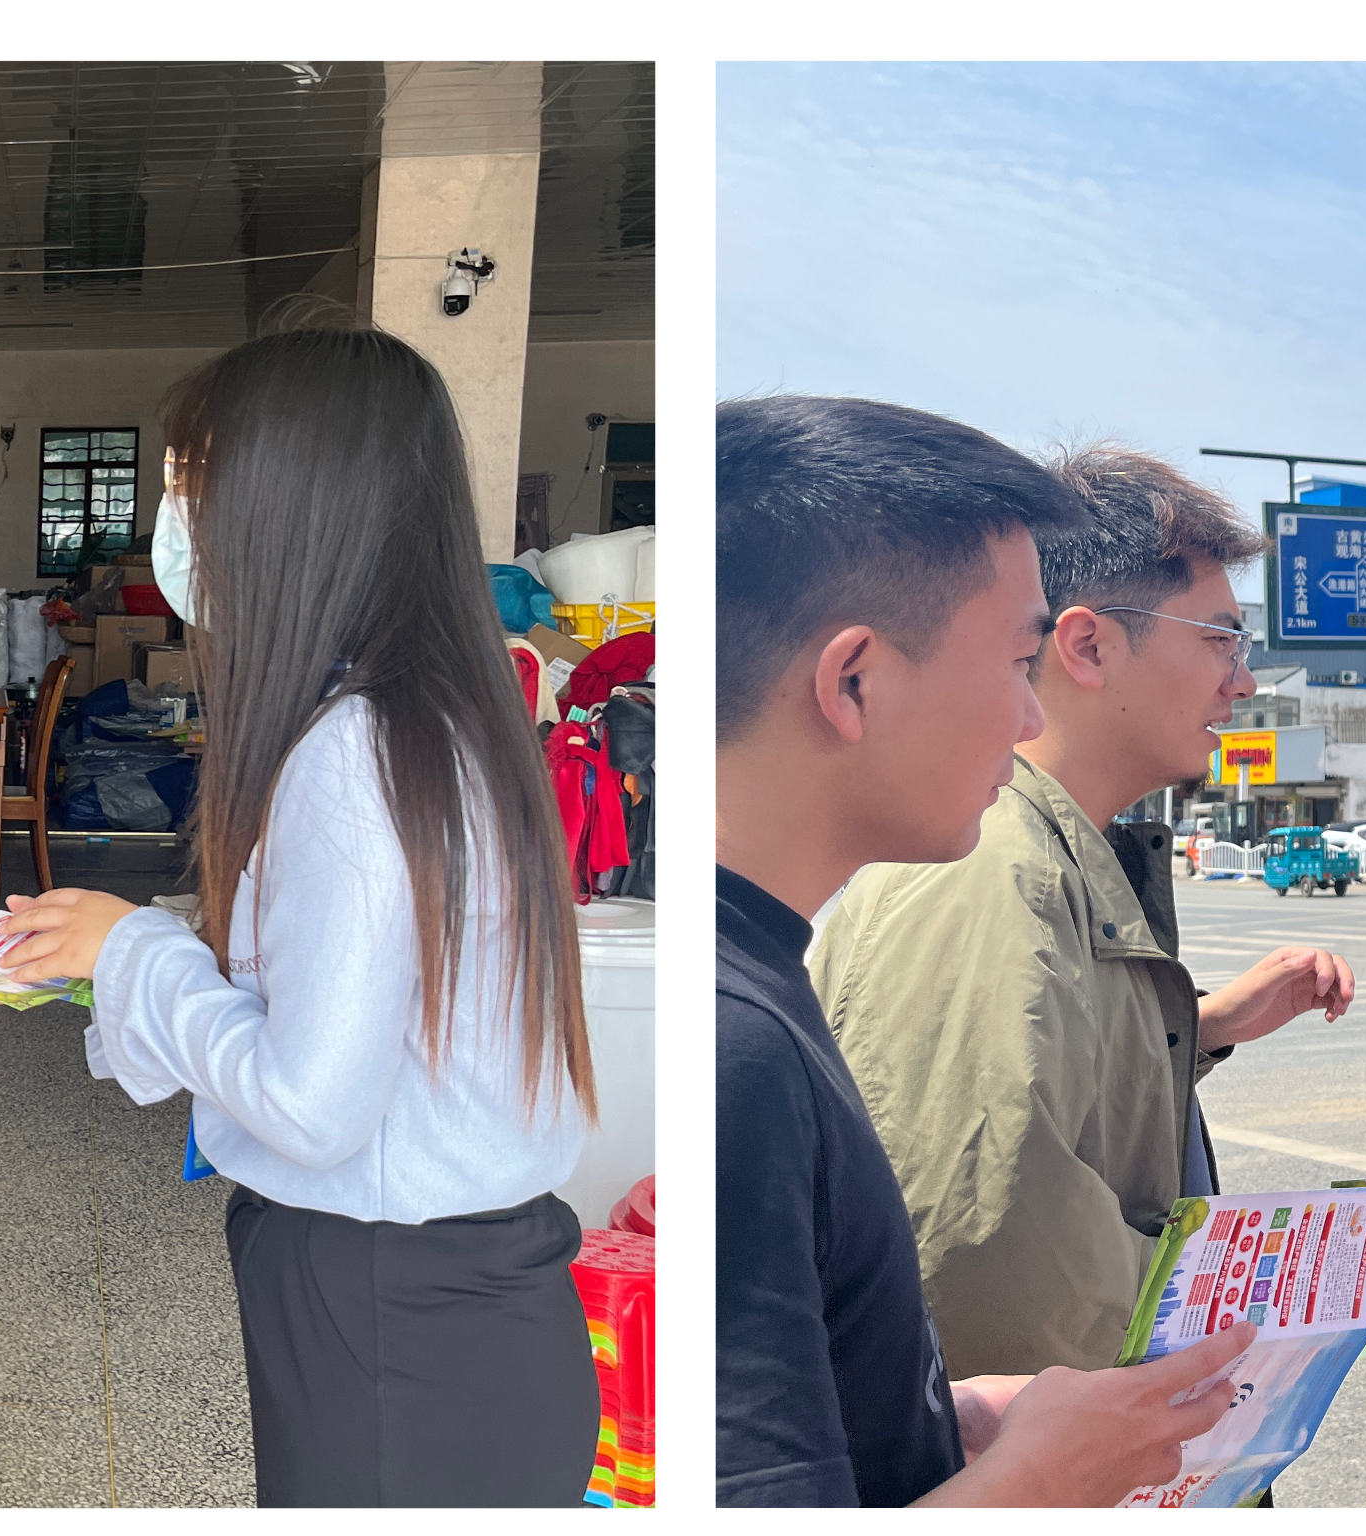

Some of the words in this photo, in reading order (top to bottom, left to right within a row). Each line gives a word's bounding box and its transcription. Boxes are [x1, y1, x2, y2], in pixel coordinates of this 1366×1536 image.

[1294, 555, 1309, 615] 宋公大道
[1287, 617, 1317, 629] 2.1km
